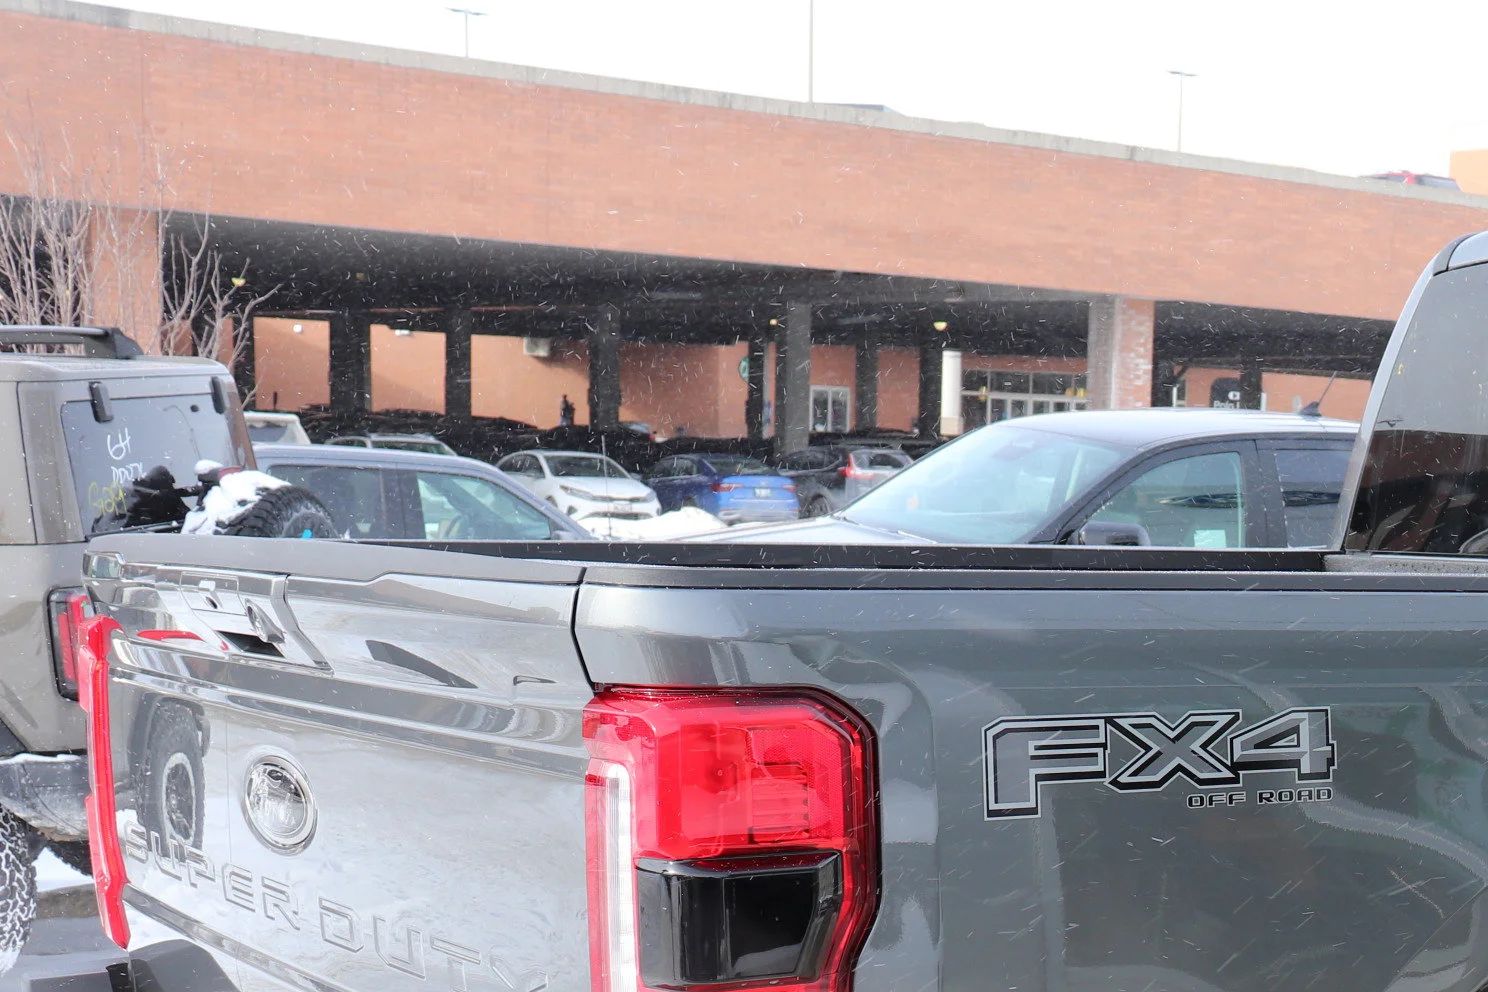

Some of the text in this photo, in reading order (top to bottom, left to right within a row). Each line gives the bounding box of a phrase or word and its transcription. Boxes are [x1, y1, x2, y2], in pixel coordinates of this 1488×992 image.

[981, 706, 1338, 821] FX4
[1187, 787, 1333, 809] OFF ROAD
[124, 819, 301, 931] SUPER
